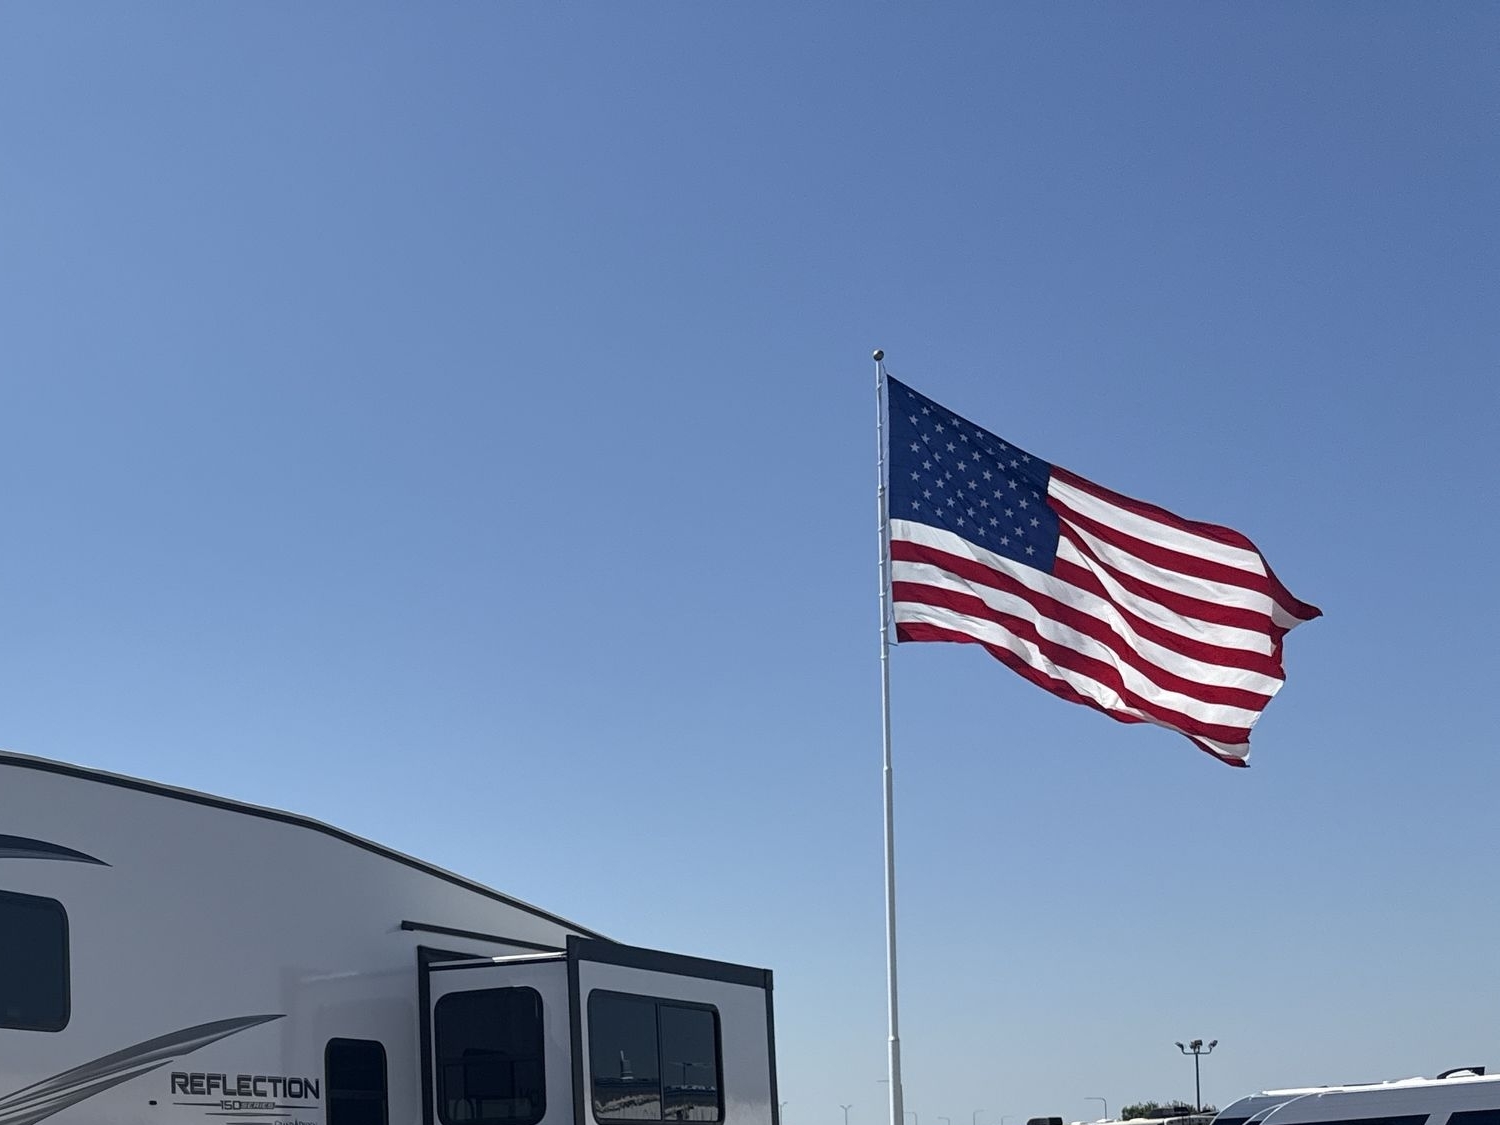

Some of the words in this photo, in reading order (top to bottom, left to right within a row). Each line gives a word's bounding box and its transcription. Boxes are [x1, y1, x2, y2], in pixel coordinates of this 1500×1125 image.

[171, 1072, 320, 1099] REFLECTION
[220, 1100, 241, 1110] 150
[241, 1102, 275, 1110] SERIES
